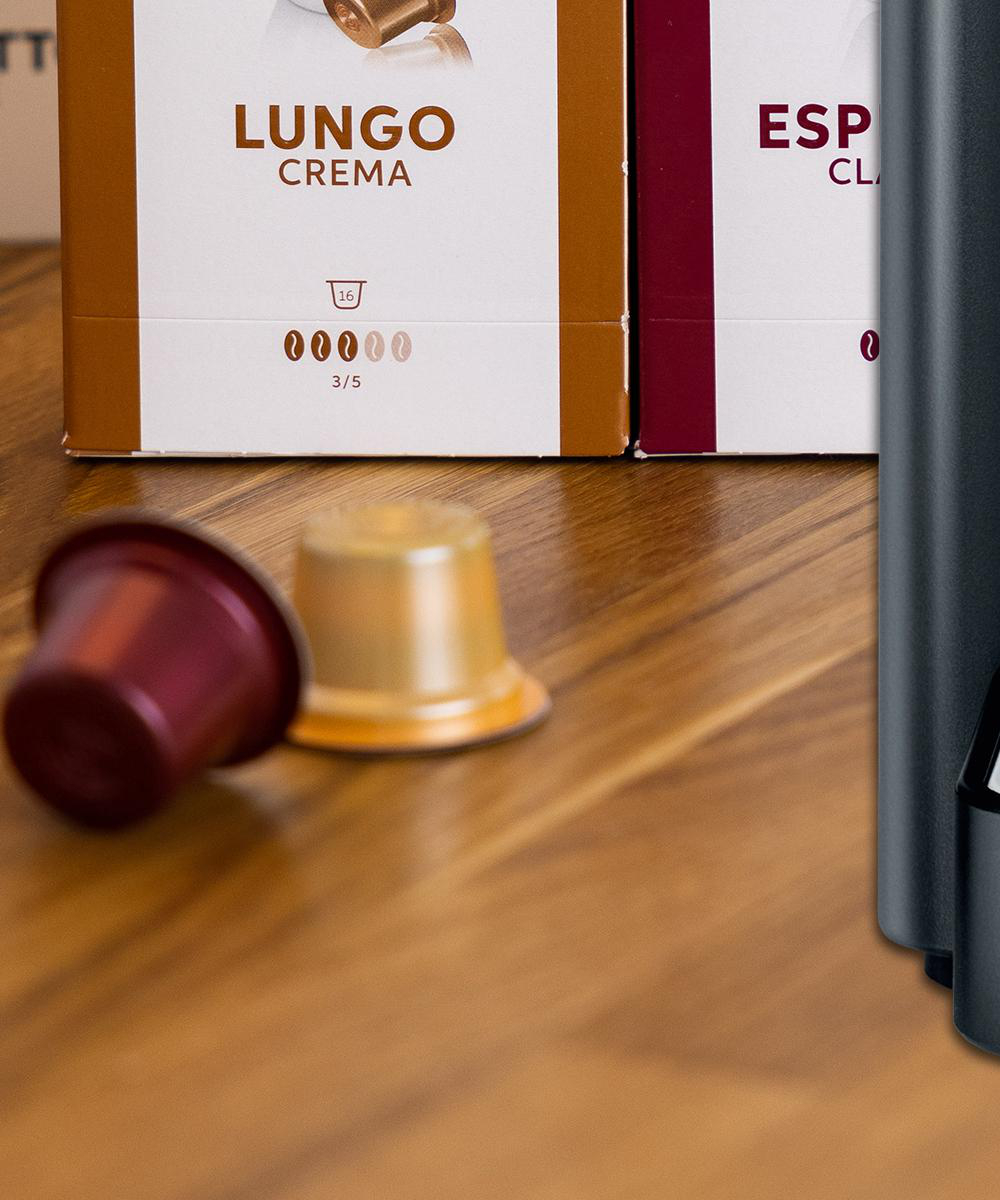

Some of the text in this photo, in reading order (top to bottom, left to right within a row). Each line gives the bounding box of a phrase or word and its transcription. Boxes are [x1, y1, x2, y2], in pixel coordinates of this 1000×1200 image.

[235, 104, 456, 151] LUNGO
[759, 103, 880, 149] ESP
[278, 158, 413, 186] CREMA
[828, 157, 880, 185] CL
[339, 290, 354, 302] 16
[332, 375, 361, 389] 3/5
